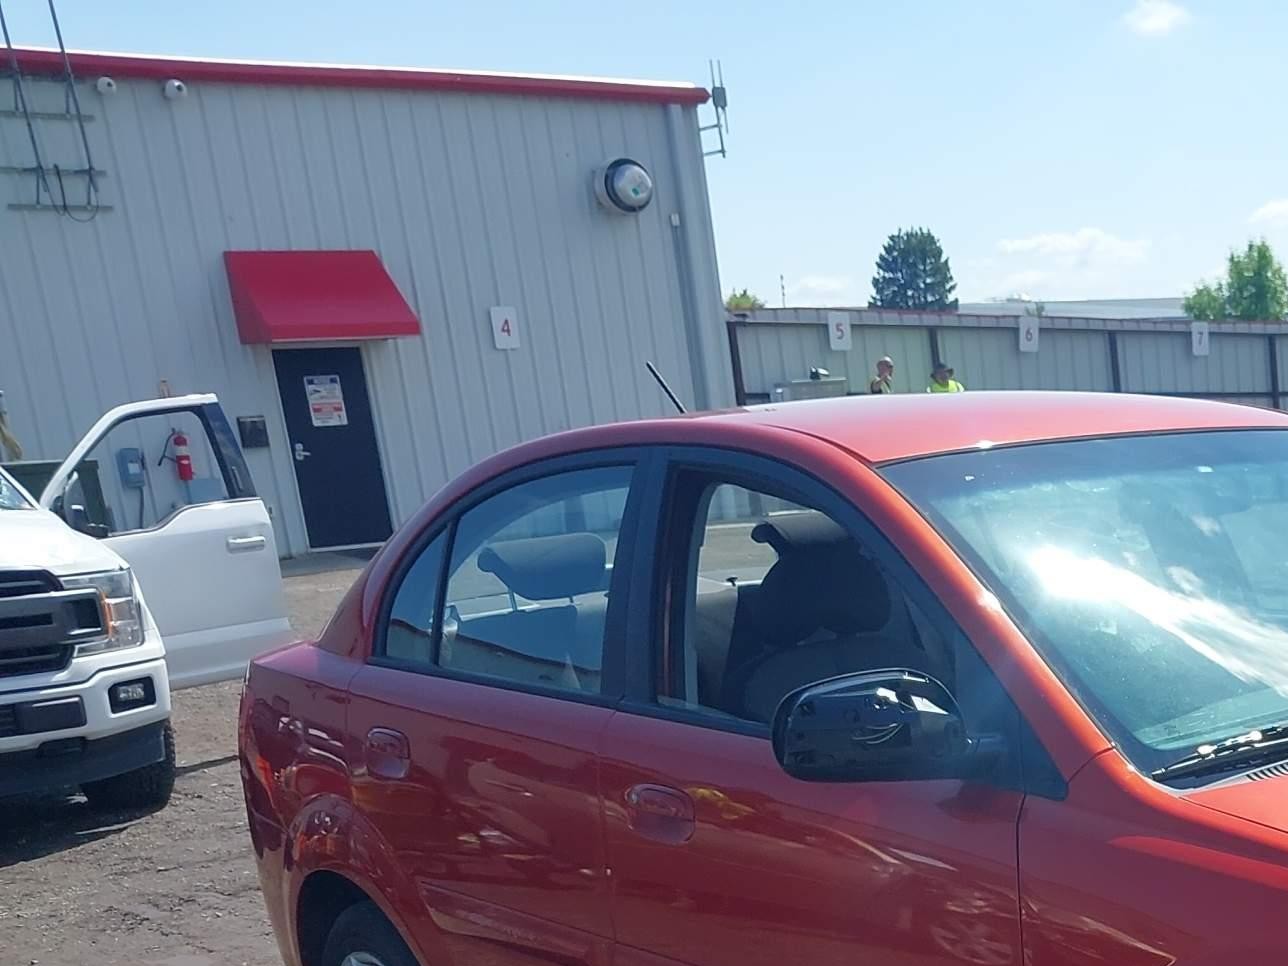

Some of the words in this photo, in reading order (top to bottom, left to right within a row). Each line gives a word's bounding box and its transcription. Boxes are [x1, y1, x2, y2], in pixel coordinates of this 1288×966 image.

[501, 318, 512, 337] 4
[835, 322, 845, 340] 5
[1025, 328, 1034, 342] 6
[1197, 331, 1204, 346] 7
